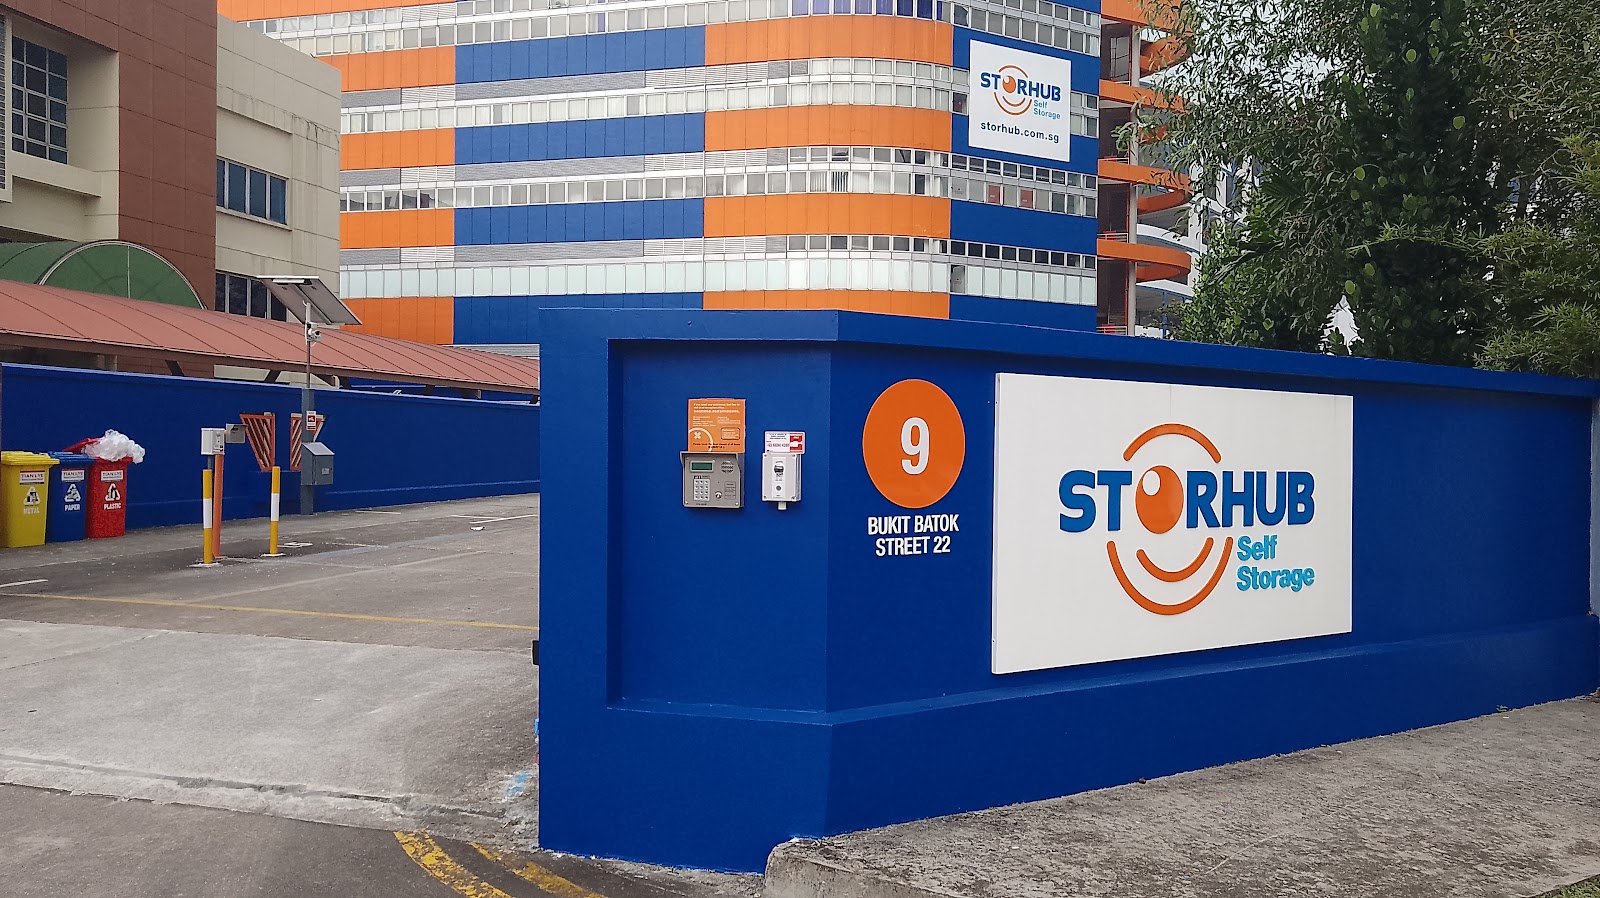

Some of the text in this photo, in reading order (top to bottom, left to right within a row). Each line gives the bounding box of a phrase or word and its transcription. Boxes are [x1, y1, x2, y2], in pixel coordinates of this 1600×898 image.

[980, 72, 1061, 102] STORHUB
[1033, 100, 1048, 109] Self
[1033, 108, 1061, 120] Storage
[980, 121, 1060, 144] storhub.com.sg
[901, 416, 930, 475] 9
[103, 502, 122, 510] PLASTIC
[1058, 465, 1315, 534] STORHUB
[23, 507, 40, 515] METAL
[868, 514, 959, 535] BUKIT BATOK
[875, 535, 951, 556] STREET 22
[1236, 535, 1278, 561] Self
[1236, 566, 1315, 592] Storage
